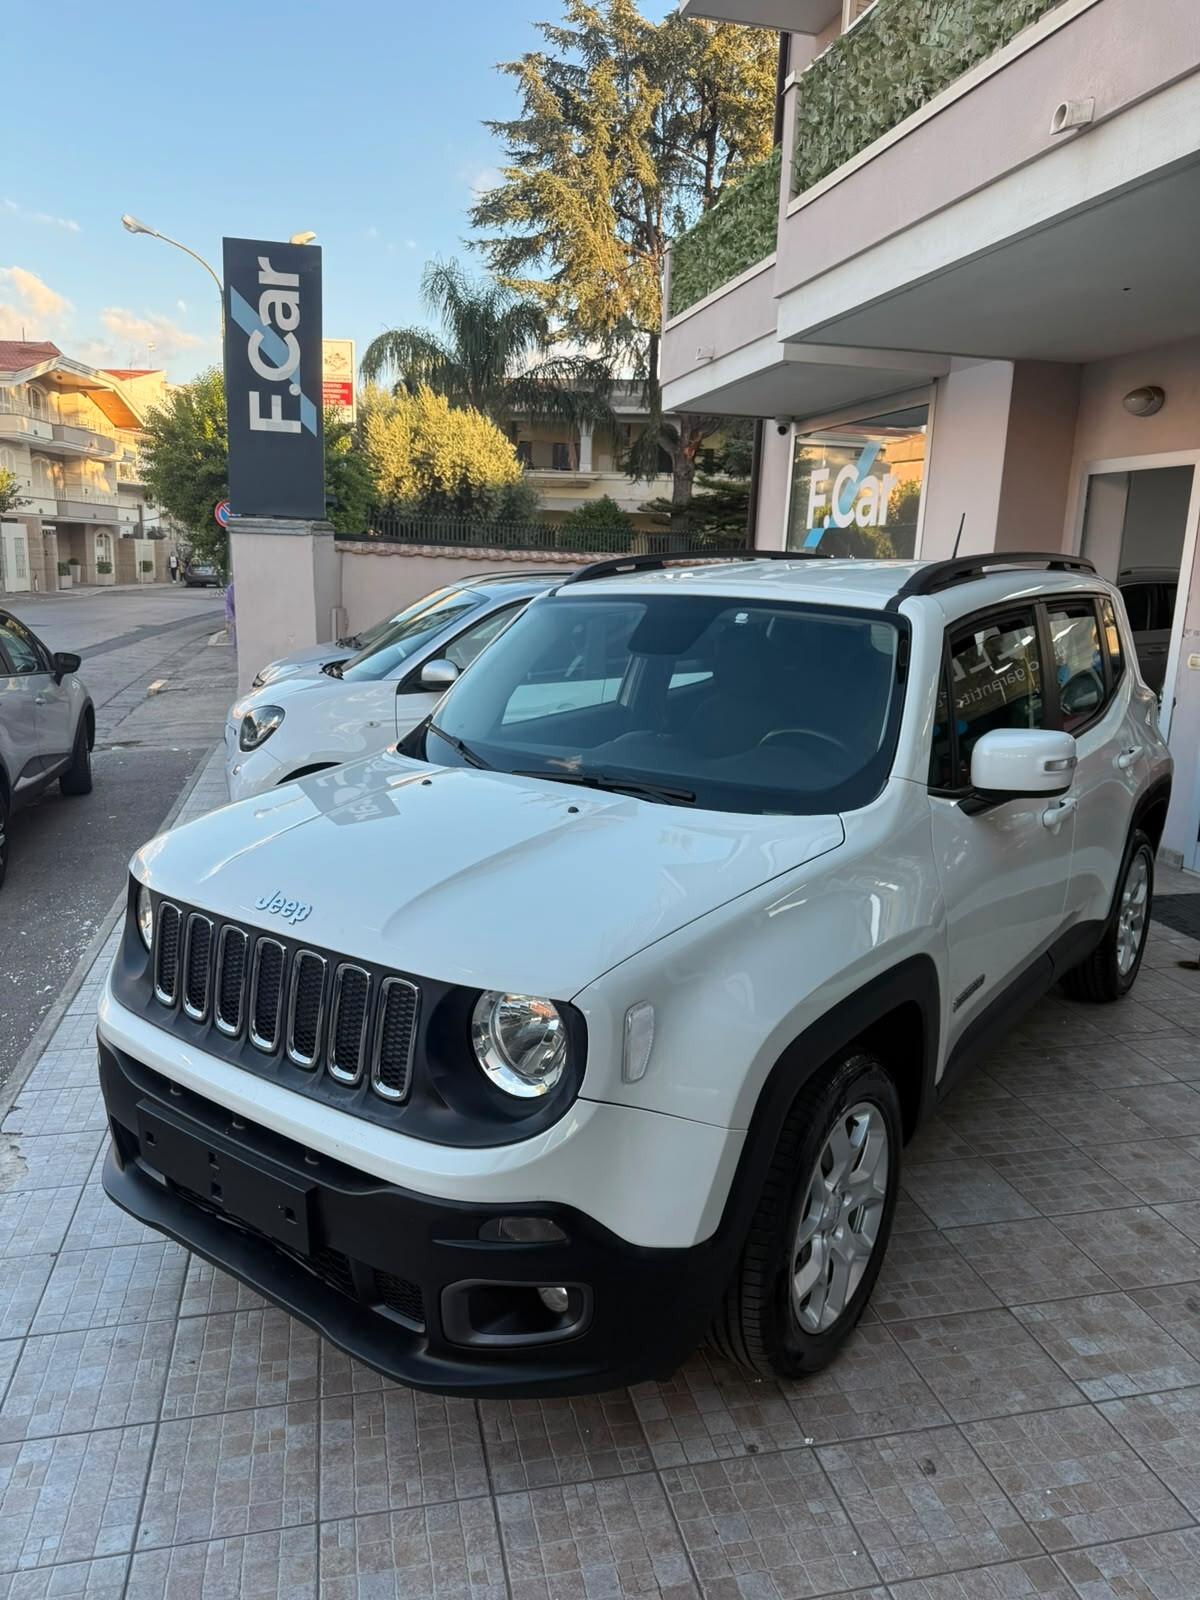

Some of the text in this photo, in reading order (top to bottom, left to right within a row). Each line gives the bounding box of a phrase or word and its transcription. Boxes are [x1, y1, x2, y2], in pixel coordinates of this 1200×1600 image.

[248, 256, 302, 434] F.Car
[806, 463, 897, 530] F.Car
[255, 889, 313, 926] Jeep
